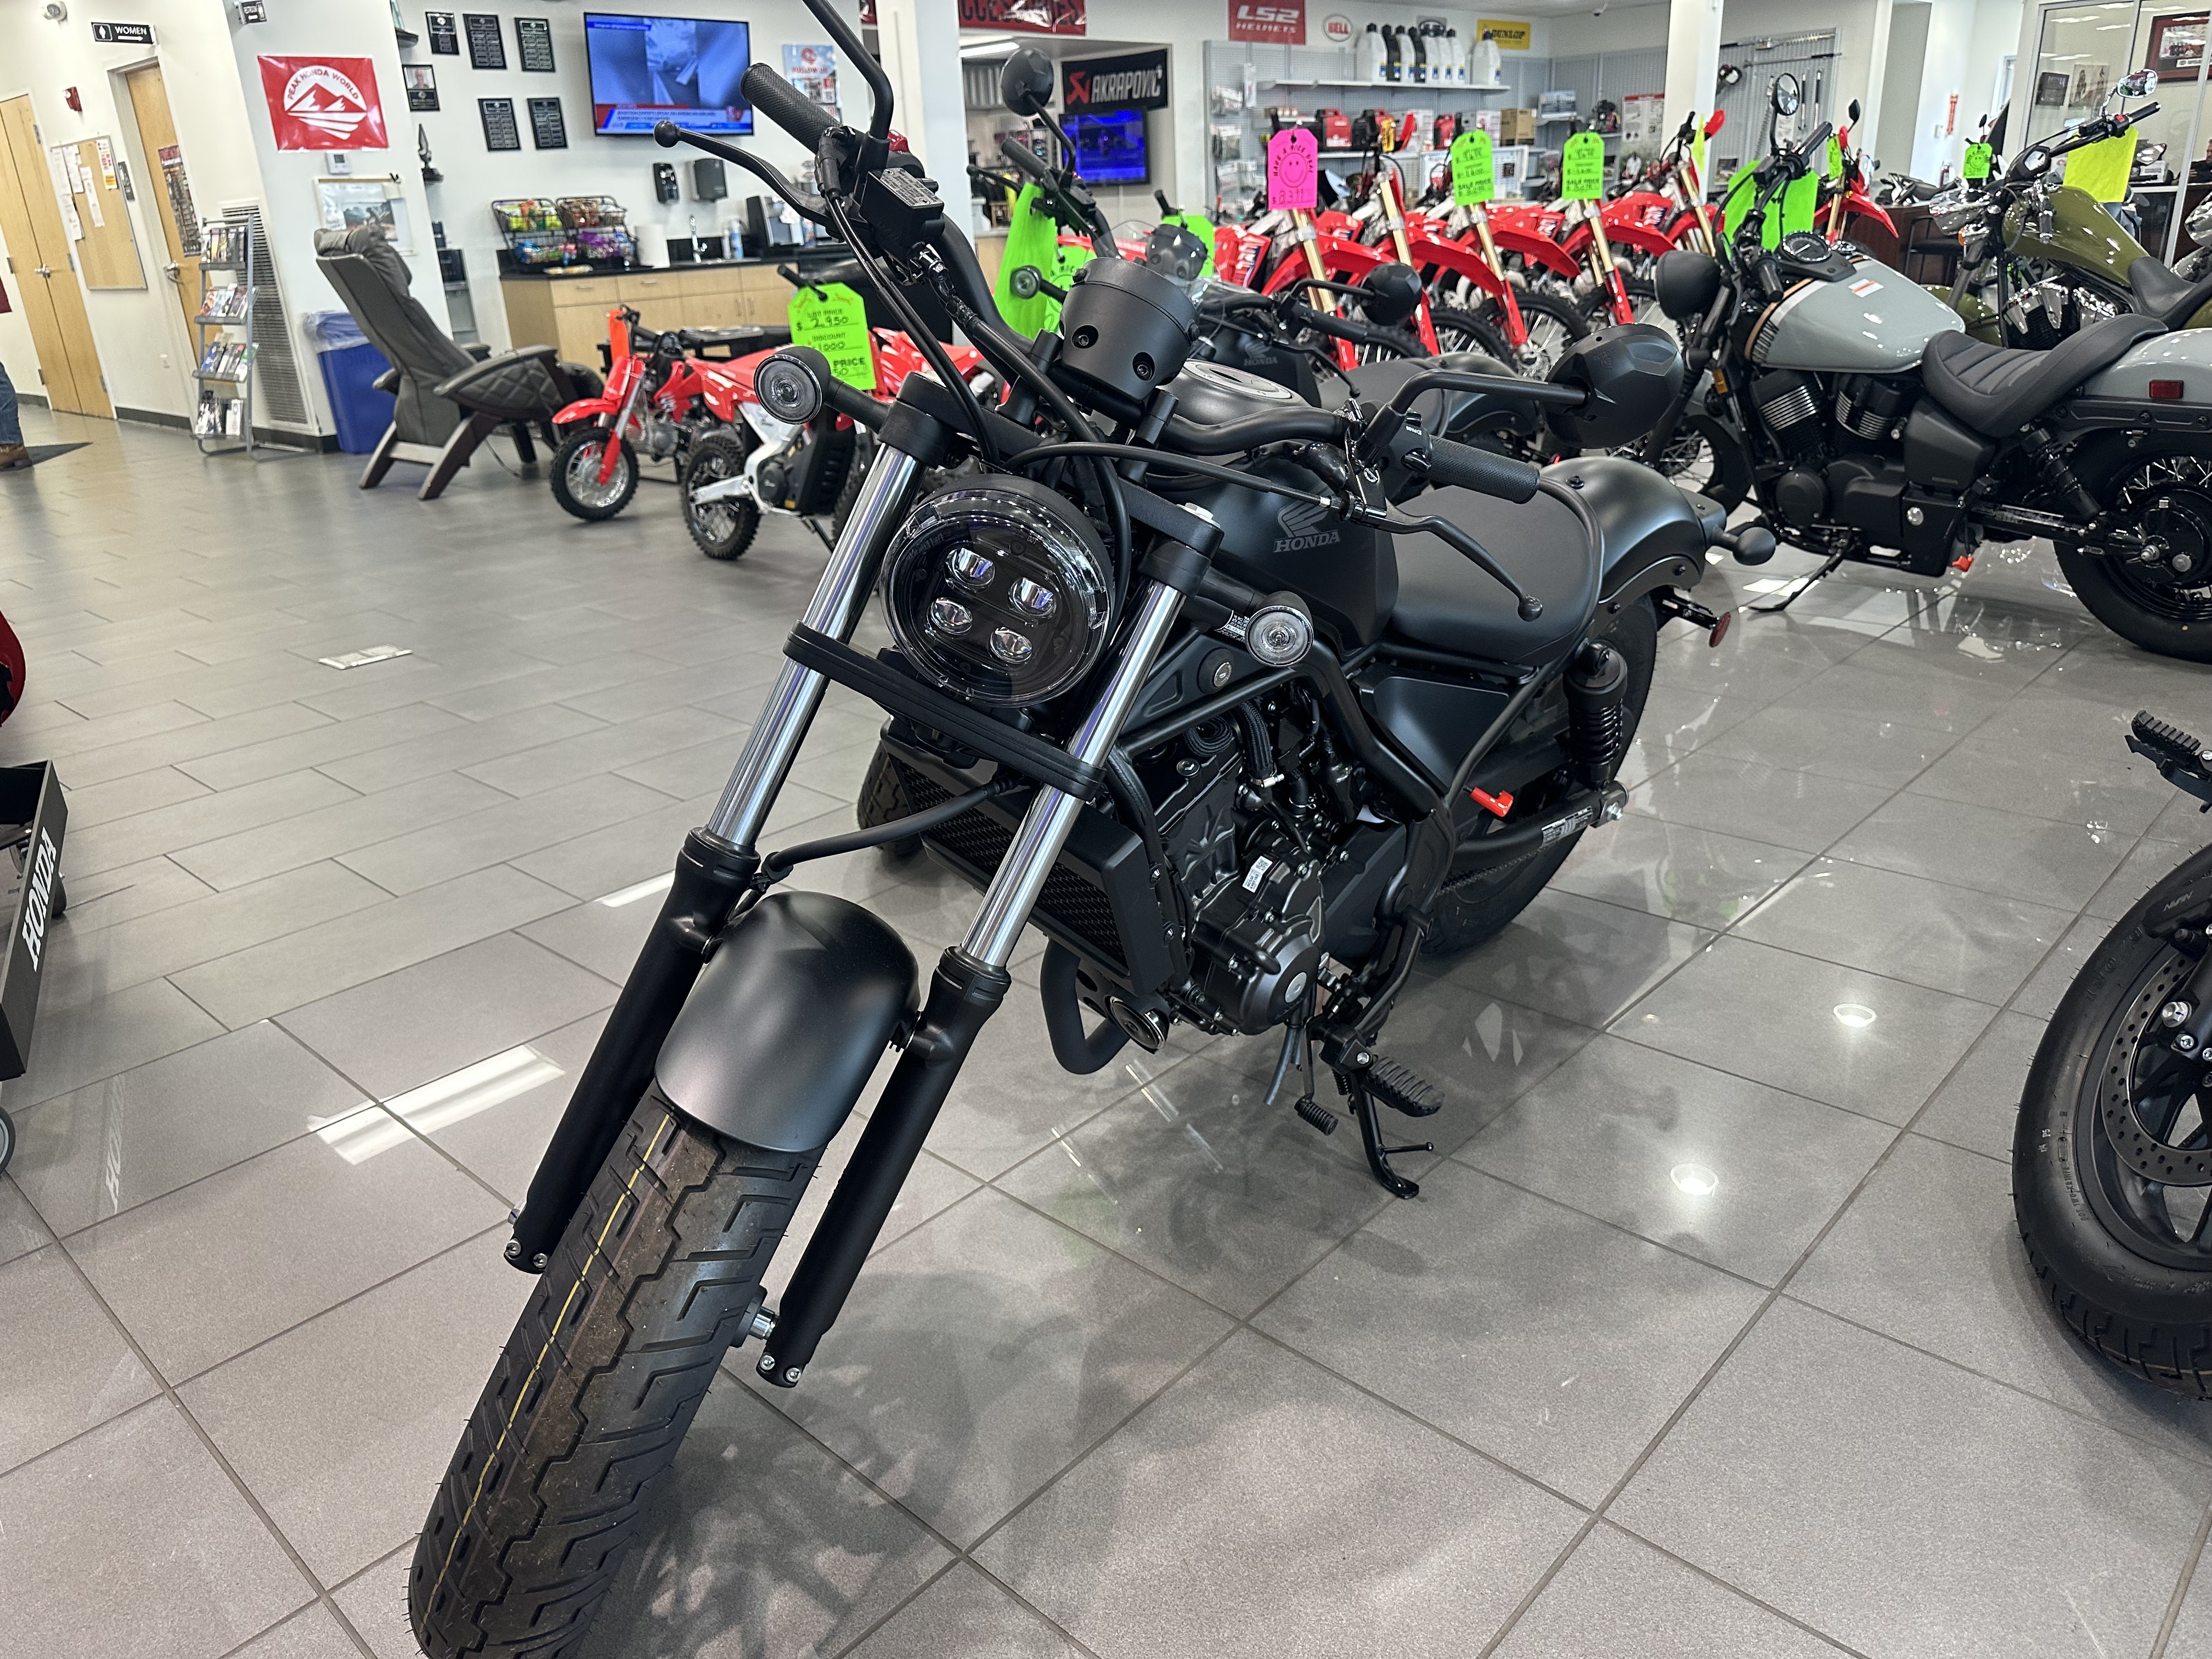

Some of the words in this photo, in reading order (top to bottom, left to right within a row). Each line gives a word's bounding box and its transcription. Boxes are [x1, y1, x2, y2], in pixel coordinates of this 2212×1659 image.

[1237, 4, 1300, 24] LS2
[114, 25, 147, 35] WOMEN
[1235, 22, 1297, 33] HELMETS
[287, 77, 301, 100] PEAK
[300, 68, 329, 80] HONDA
[332, 72, 359, 100] WORLD
[833, 357, 866, 369] PRICE
[1243, 357, 1278, 366] HONDA
[1273, 532, 1341, 553] HONDA
[22, 826, 57, 972] HONDA
